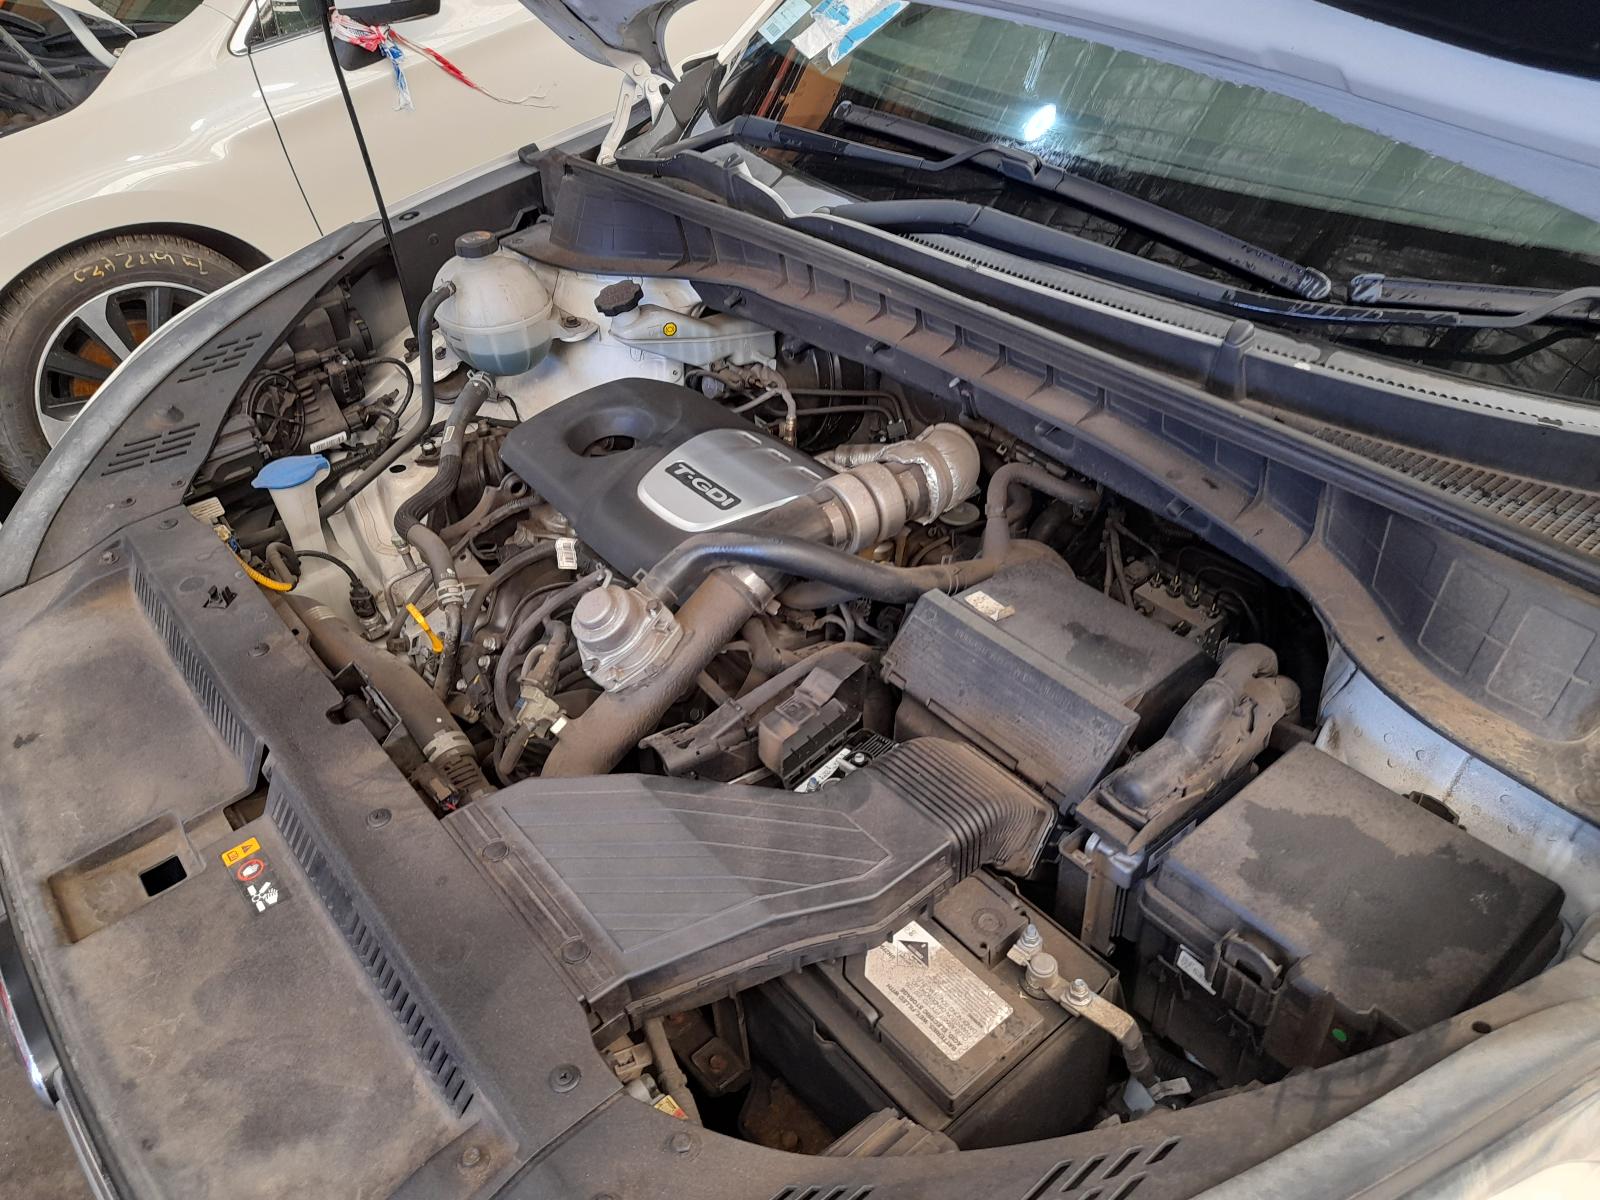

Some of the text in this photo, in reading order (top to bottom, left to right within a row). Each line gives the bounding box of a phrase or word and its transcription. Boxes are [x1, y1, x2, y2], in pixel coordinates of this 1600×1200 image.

[885, 982, 900, 996] WITH
[897, 994, 916, 1012] FILLED
[899, 987, 923, 1010] STORAGE
[914, 1010, 928, 1024] WET,
[922, 1008, 948, 1033] ELECTRIC
[927, 1022, 957, 1051] BATTERIES,
[946, 1031, 963, 1047] ACID,
